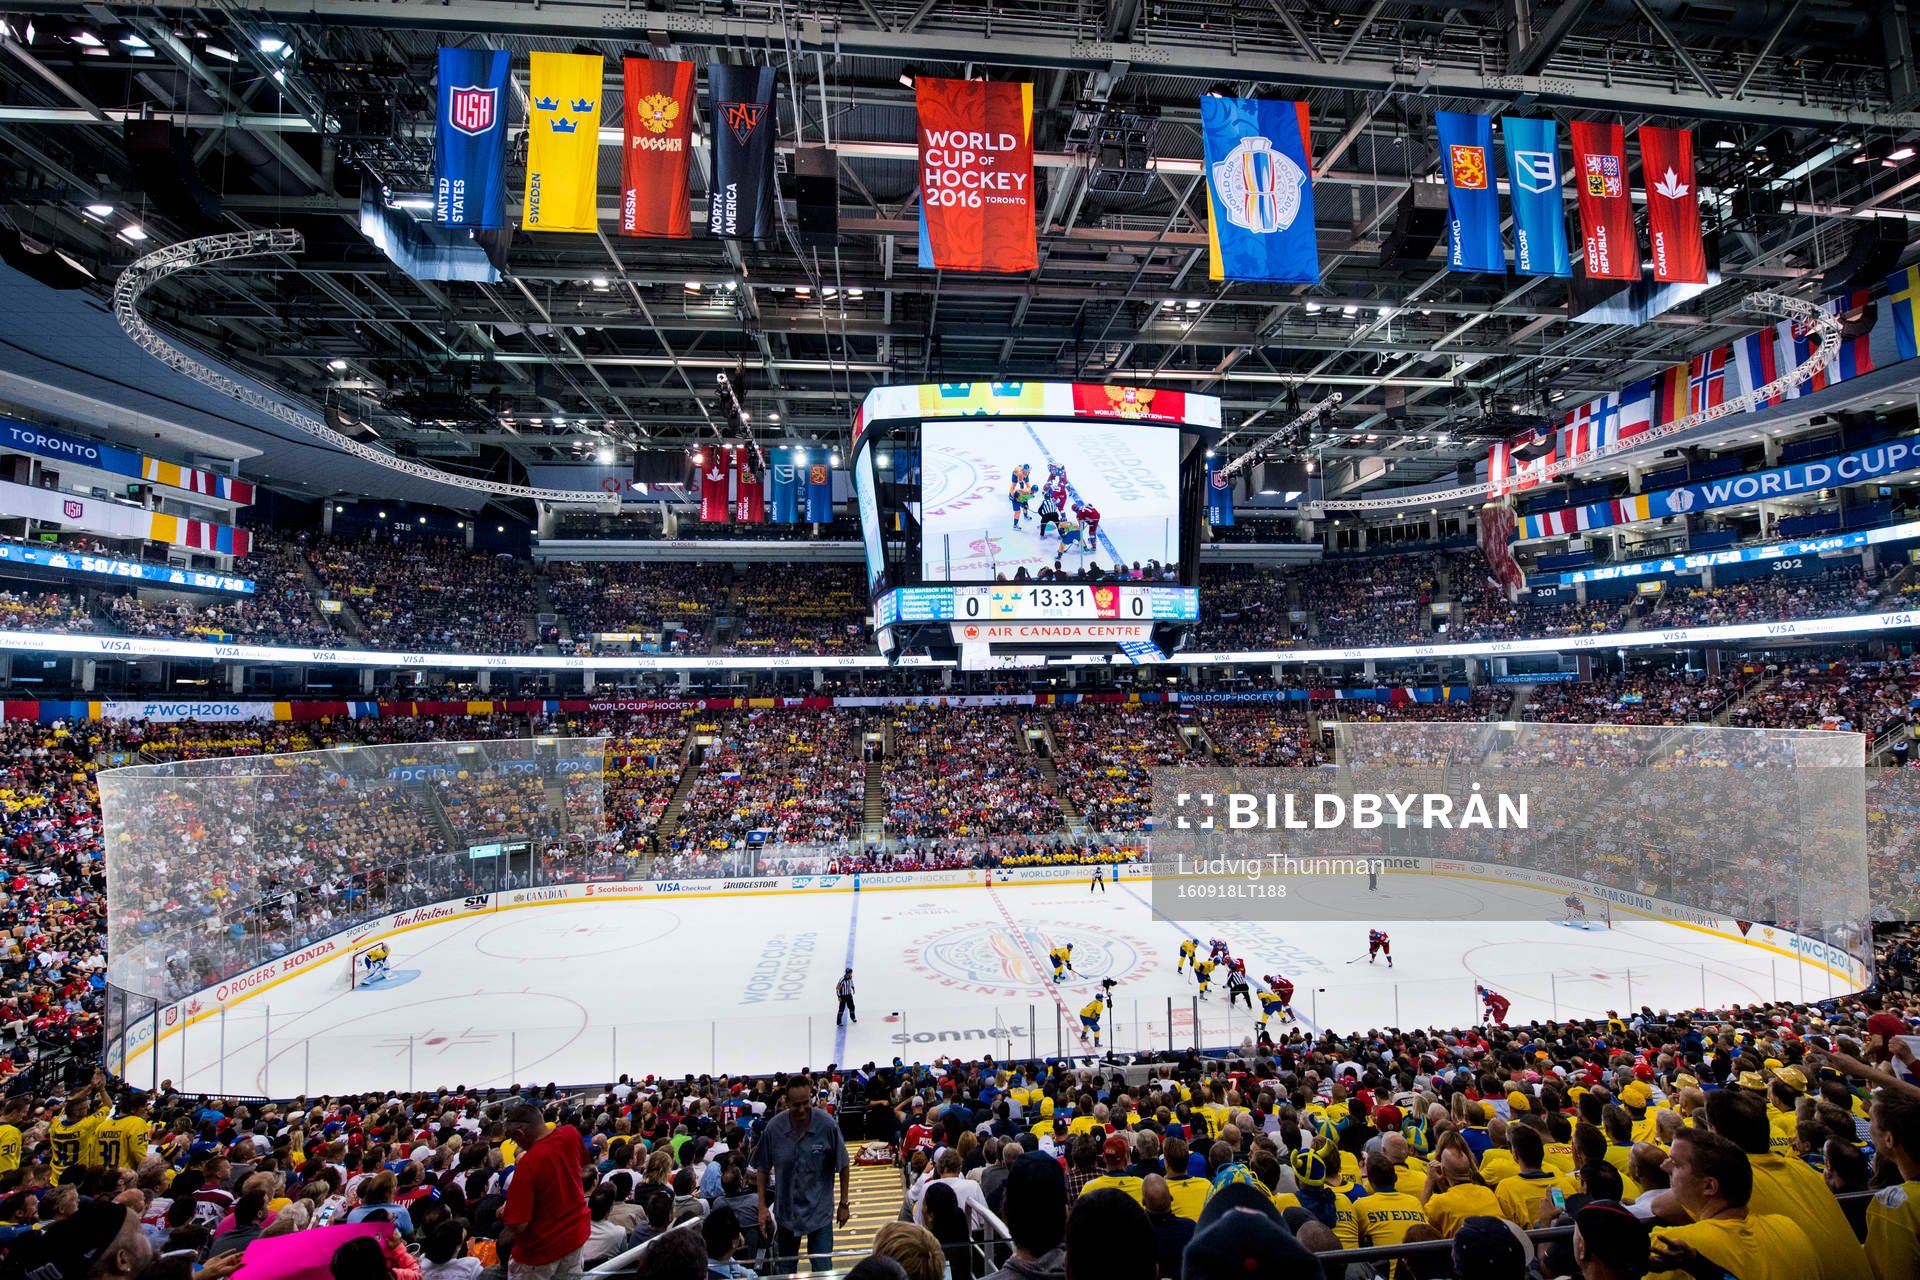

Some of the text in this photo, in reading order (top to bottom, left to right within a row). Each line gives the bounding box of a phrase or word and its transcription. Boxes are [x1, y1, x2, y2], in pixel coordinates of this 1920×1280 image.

[457, 94, 490, 128] USA
[632, 136, 682, 151] РОССИЯ
[925, 129, 1016, 150] WORLD
[926, 149, 994, 168] CUP OF
[926, 168, 1027, 190] HOCKEY
[1223, 161, 1242, 214] WORLD CUP
[1276, 159, 1295, 214] HOCKEY 2016
[437, 178, 449, 221] UNITED
[452, 180, 464, 222] STATES
[529, 173, 540, 223] SWEDEN
[926, 188, 1026, 208] 2016 TORONTO
[625, 189, 636, 230] RUSSIA
[712, 193, 722, 234] NORTH
[726, 184, 737, 234] AMERICA
[1453, 220, 1462, 265] FINLAND
[1521, 229, 1530, 270] EUROPE
[1600, 226, 1610, 274] REPUBLIC
[1590, 238, 1599, 274] CZECH
[1658, 232, 1667, 276] CANADA
[10, 428, 98, 460] TORONTO
[1702, 444, 1908, 504] WORLD CUP
[66, 502, 82, 517] USA
[81, 557, 142, 578] 50/50
[1685, 550, 1742, 568] 50/50
[1772, 558, 1802, 570] 302
[194, 570, 244, 592] 50/50
[1594, 564, 1642, 580] 50/50
[1030, 589, 1084, 606] 13:31
[1537, 588, 1556, 597] 301
[966, 597, 979, 616] 0
[1132, 597, 1144, 616] 0
[1881, 614, 1912, 625] VISA
[988, 626, 1140, 636] AIR CANADA CENTRE
[1663, 632, 1688, 640] VISA
[1768, 624, 1795, 634] VISA
[100, 640, 131, 650] VISA
[1574, 638, 1595, 646] VISA
[215, 648, 240, 656] VISA
[313, 652, 336, 660] VISA
[403, 656, 425, 664] VISA
[143, 704, 240, 716] #WCH2016
[1020, 870, 1070, 878] WORLD CUP
[1434, 862, 1466, 872] ESPN
[1504, 870, 1532, 881] Synergy
[656, 882, 680, 892] VISA
[723, 881, 778, 890] BRIDGESTONE
[792, 878, 809, 886] SAP
[820, 878, 837, 886] SAP
[861, 874, 956, 884] WORLD CUP HOCKEY
[1536, 875, 1580, 890] AIR CANADA
[526, 889, 568, 901] CANADIAN
[598, 884, 644, 893] Scotiabank
[464, 895, 489, 903] SN
[1594, 886, 1652, 910] SAMSUNG
[393, 906, 454, 928] Tim Hortons
[1674, 909, 1719, 928] CANADIAN
[283, 942, 336, 971] HONDA
[738, 940, 788, 1005] WORLD CUP
[773, 932, 818, 1000] HOCKEY 2016
[231, 966, 276, 995] ROGERS
[892, 1026, 1028, 1044] sonnet
[1137, 1132, 1148, 1145] 30
[2, 1142, 16, 1156] 30
[53, 1140, 80, 1166] 30
[98, 1140, 120, 1169] 30
[1368, 1210, 1425, 1223] SWEDEN
